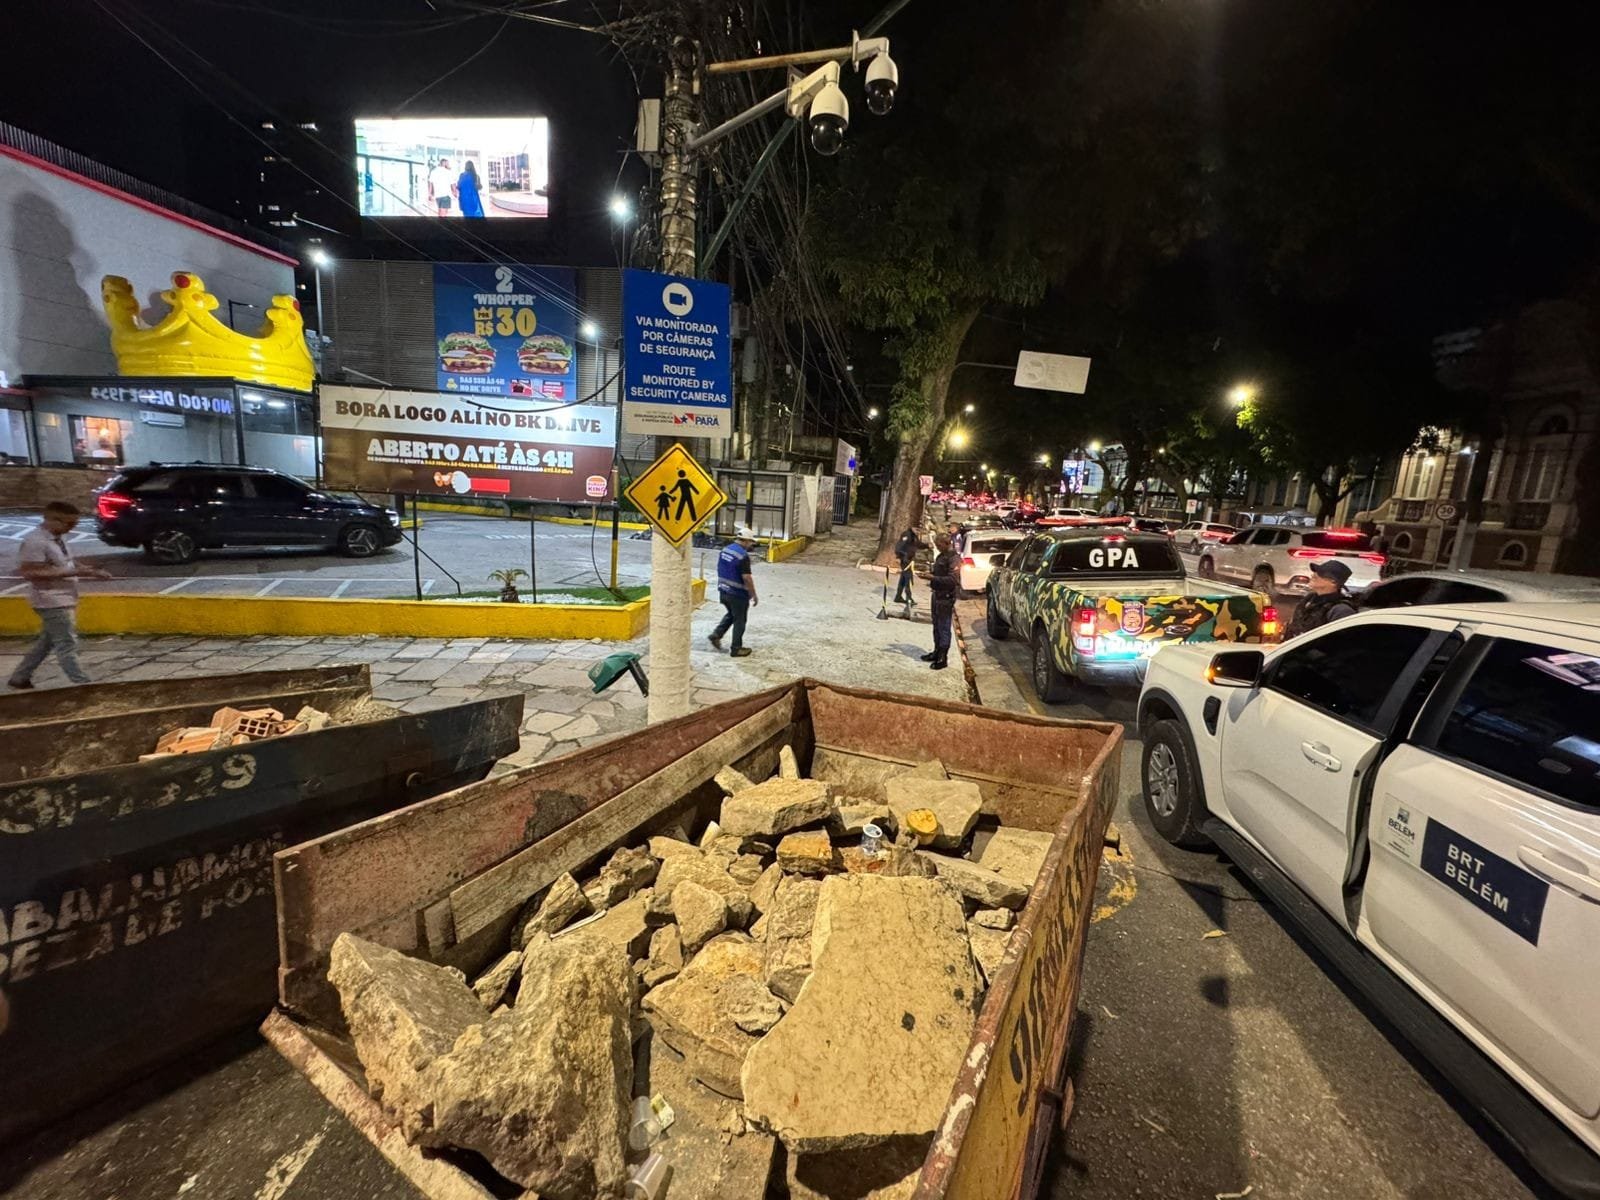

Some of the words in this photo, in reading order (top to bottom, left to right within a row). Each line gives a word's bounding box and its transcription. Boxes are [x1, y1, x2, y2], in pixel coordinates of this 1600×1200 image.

[495, 266, 513, 293] 2
[474, 294, 536, 305] WHOPPER
[475, 321, 494, 337] R$
[496, 307, 537, 337] 30
[636, 316, 654, 327] VIA
[655, 318, 719, 334] MONITORADA
[643, 330, 664, 342] POR
[666, 332, 713, 347] CÂMERAS
[640, 343, 654, 353] DE
[656, 345, 716, 360] SEGURANÇA
[663, 364, 696, 376] ROUTE
[642, 375, 700, 388] MONITORED
[702, 381, 715, 390] BY
[630, 387, 679, 399] SECURITY
[681, 392, 727, 403] CAMERAS
[335, 400, 391, 418] BORA
[394, 405, 446, 421] LOGO
[485, 412, 511, 426] NO
[515, 415, 542, 429] BK
[367, 438, 460, 460] ABERTO
[463, 442, 507, 463] ATÉ
[510, 442, 540, 466] ÀS
[542, 450, 573, 468] 4H
[1089, 548, 1139, 568] GPA
[1447, 843, 1485, 874] BRT
[1444, 862, 1509, 913] BELÉM
